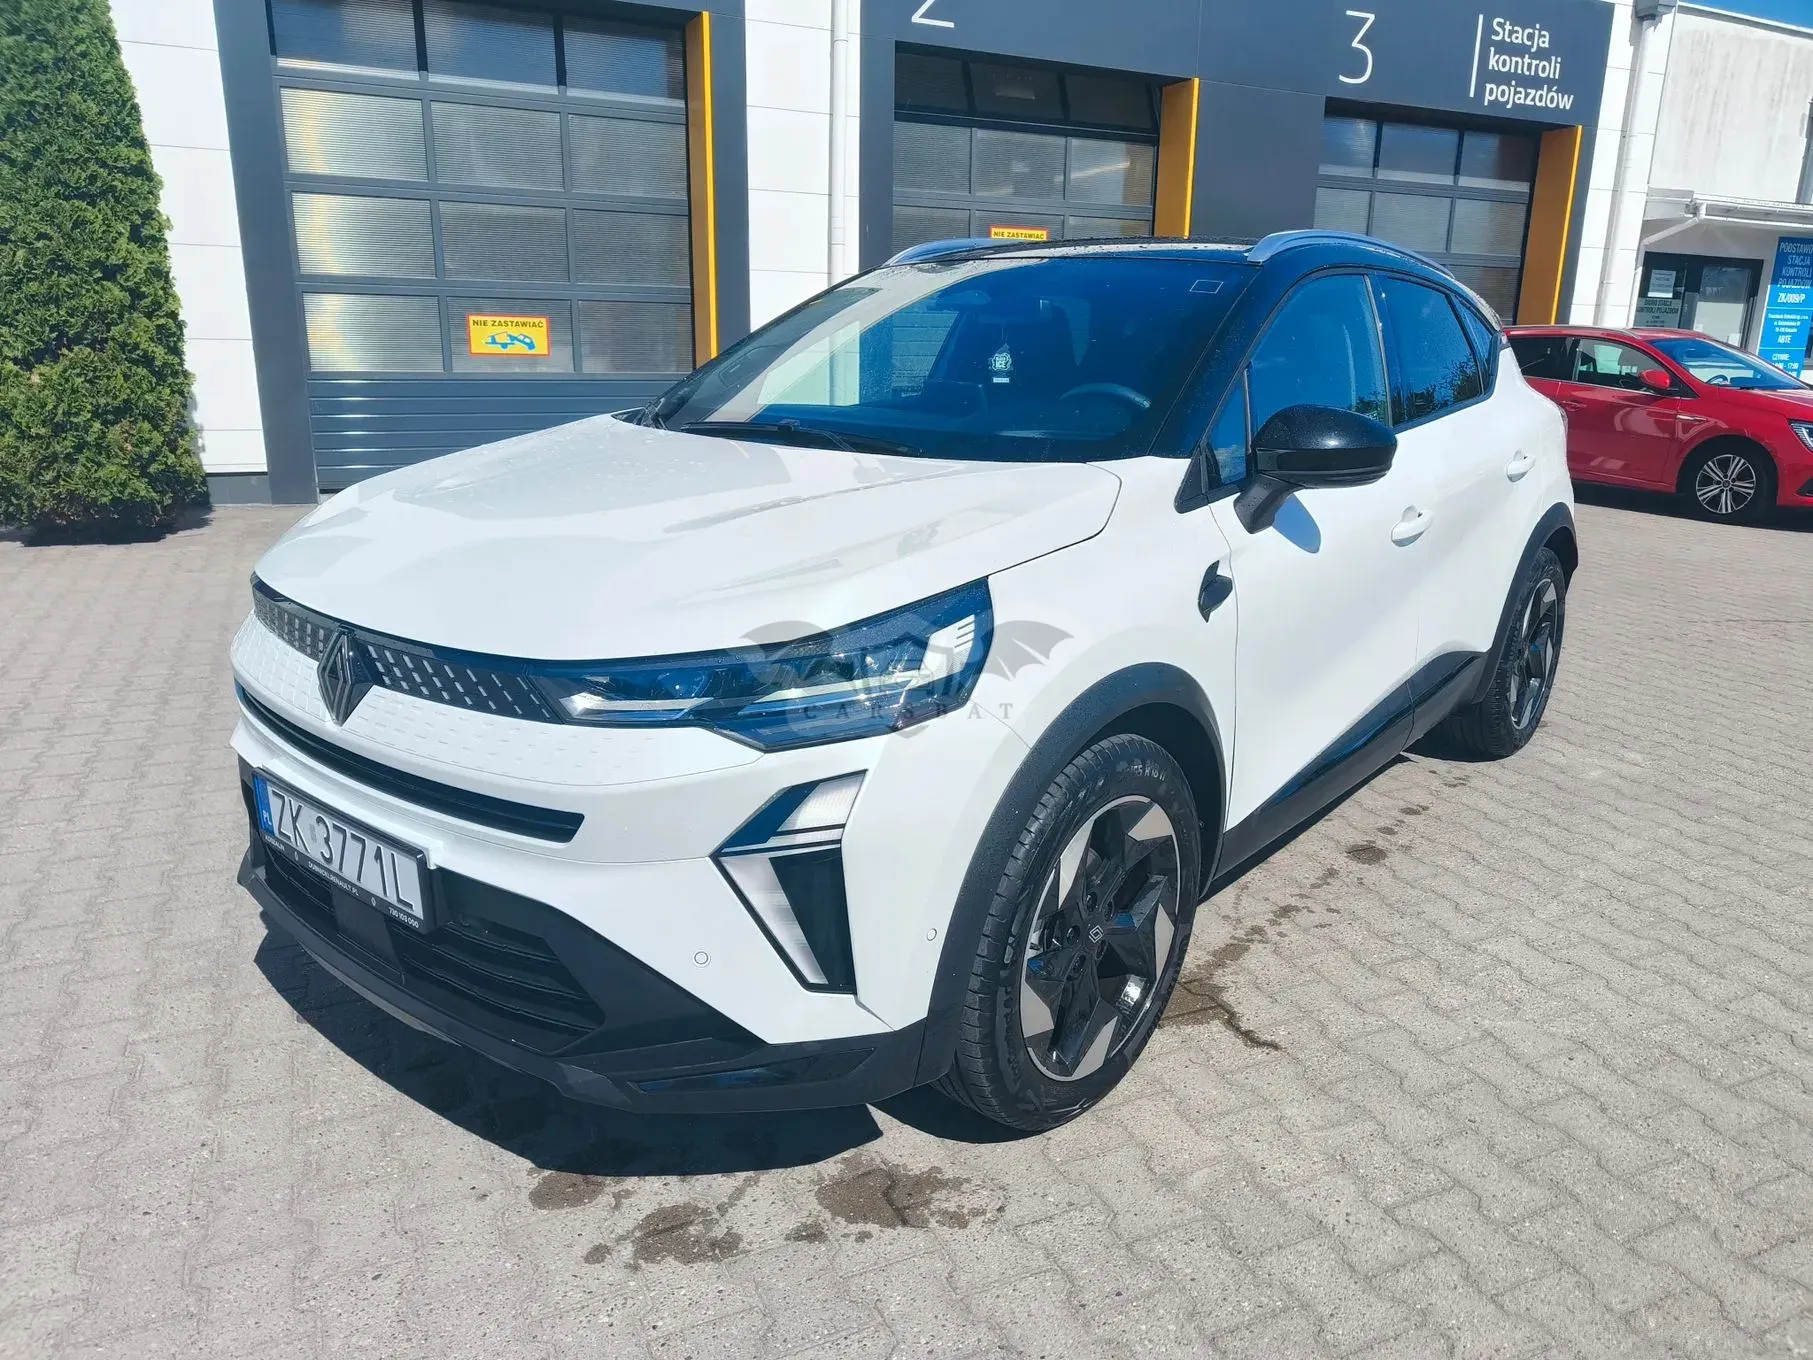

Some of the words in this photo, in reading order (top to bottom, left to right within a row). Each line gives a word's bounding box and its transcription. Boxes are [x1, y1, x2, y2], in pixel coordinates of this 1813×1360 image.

[1338, 9, 1375, 84] 3
[1491, 17, 1550, 52] Stacja
[1488, 47, 1561, 80] kontroli
[1484, 81, 1574, 110] pojazdów
[1782, 266, 1813, 278] KONTROLI
[1787, 255, 1811, 266] STACJA
[472, 319, 489, 327] NIE
[262, 809, 273, 826] PL
[271, 788, 311, 854] ZK
[314, 814, 415, 913] 3771L
